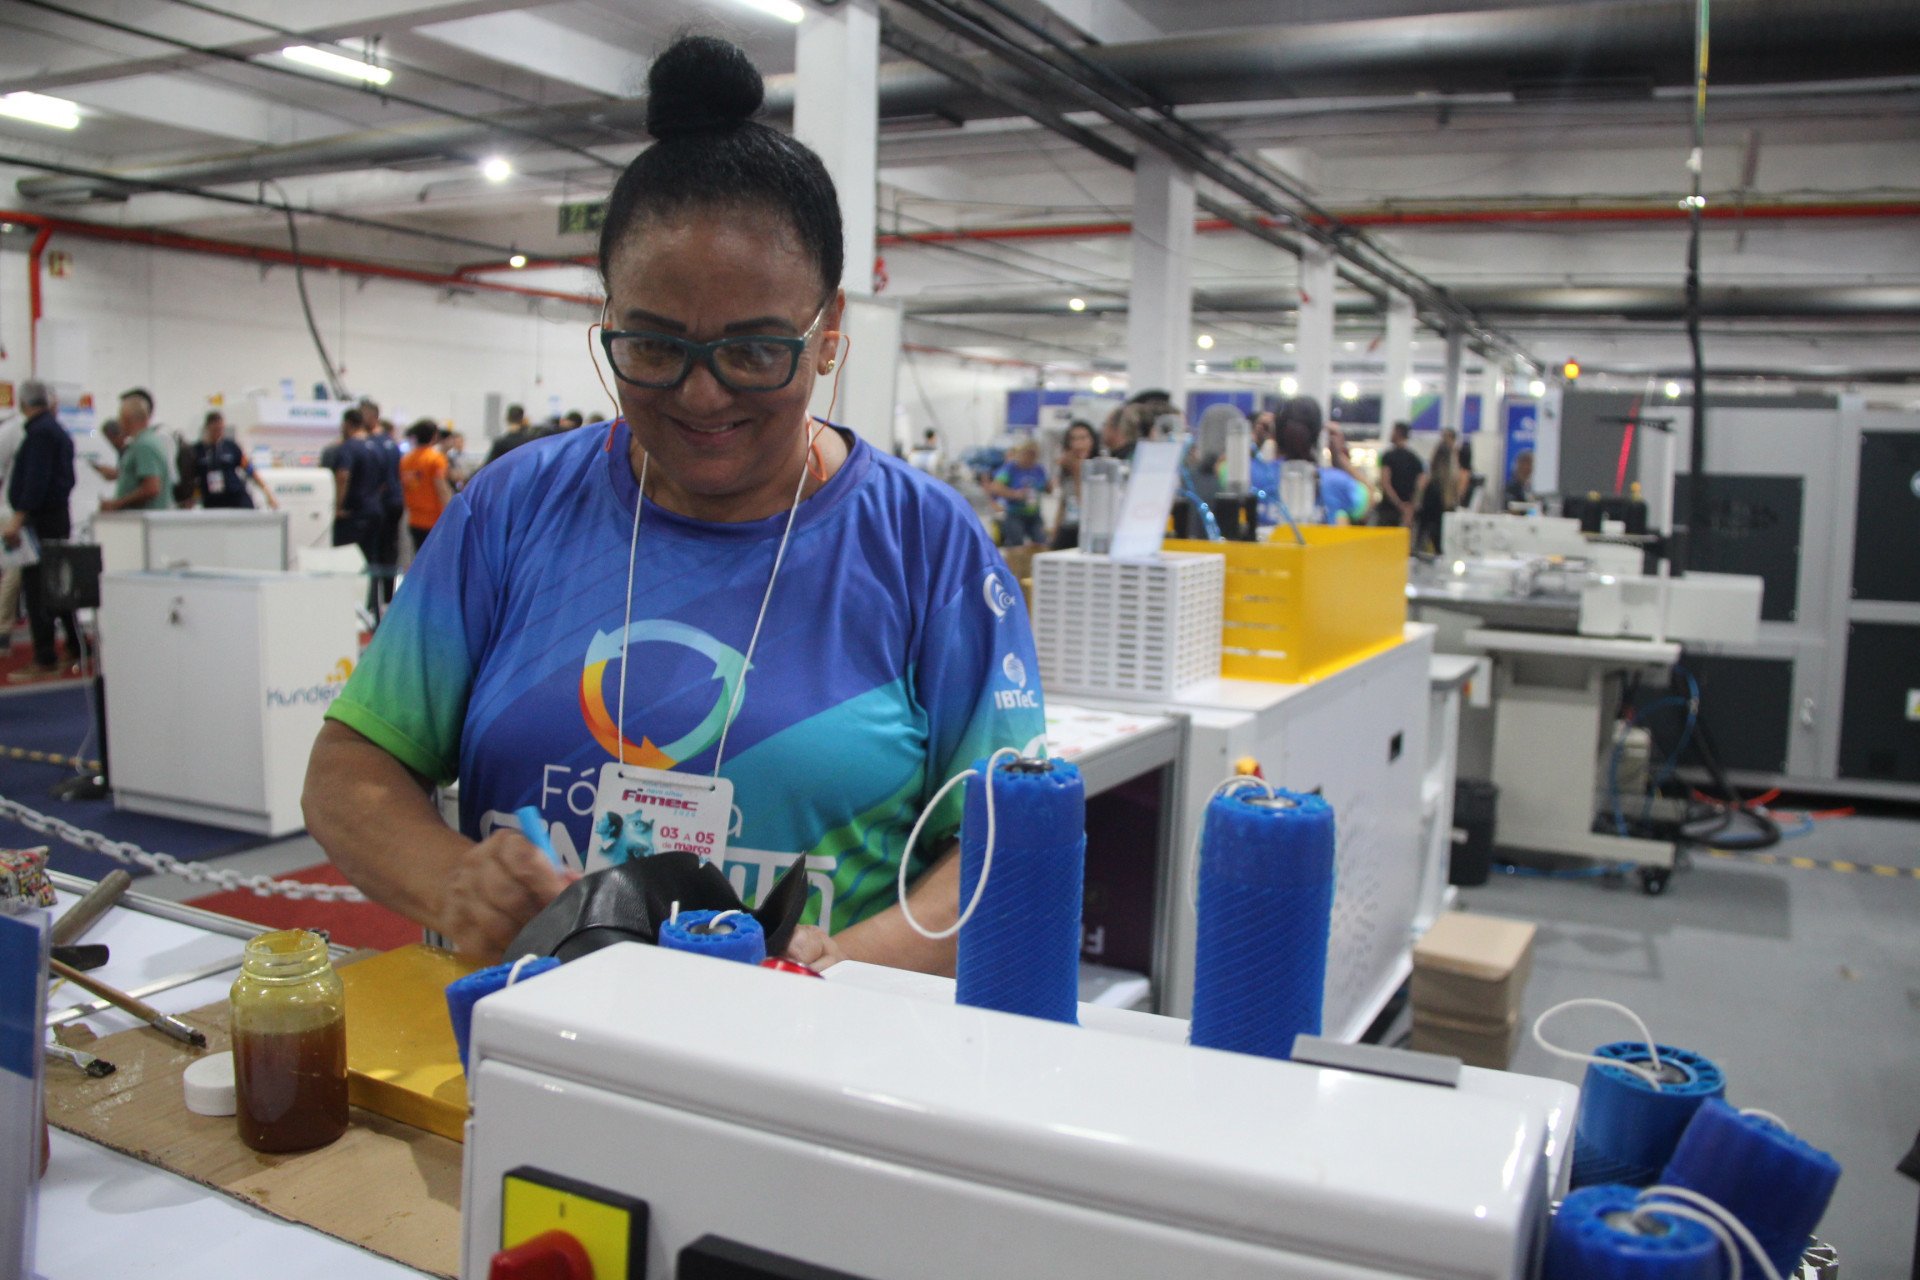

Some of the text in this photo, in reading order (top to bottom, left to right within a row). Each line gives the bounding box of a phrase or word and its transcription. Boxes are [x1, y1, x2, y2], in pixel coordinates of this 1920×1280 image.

[660, 826, 715, 844] 03 A 05
[674, 842, 711, 856] março
